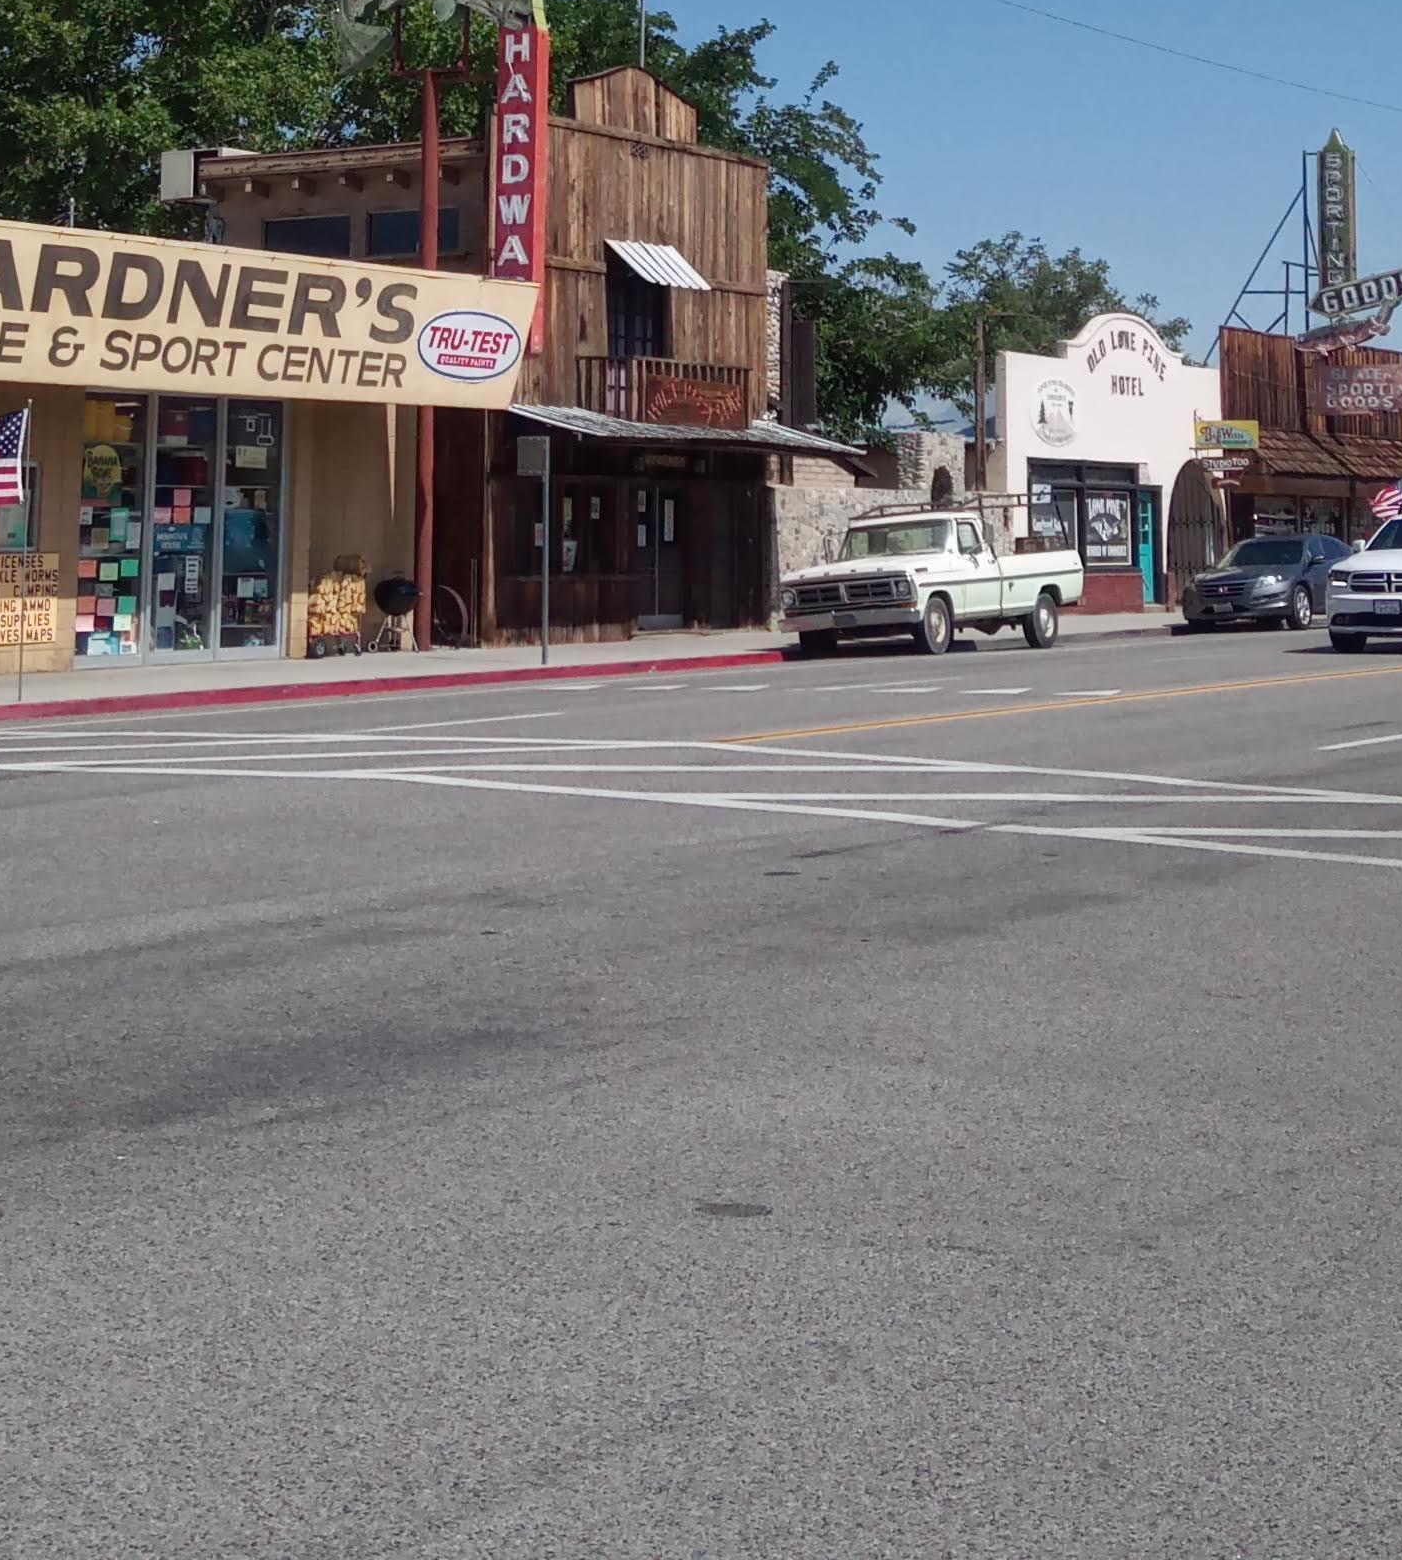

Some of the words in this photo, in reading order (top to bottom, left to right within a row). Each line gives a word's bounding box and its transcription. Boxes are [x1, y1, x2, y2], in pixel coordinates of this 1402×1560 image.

[497, 33, 532, 280] HARDWA
[1325, 152, 1344, 284] SPORTING
[429, 326, 514, 355] TRU-TEST
[48, 325, 85, 368] &
[99, 328, 247, 377] SPORT
[256, 343, 408, 388] CENTER
[440, 355, 469, 366] QUALITY
[470, 358, 494, 368] PAINTS
[1087, 339, 1107, 374] OLD
[1111, 331, 1136, 351] LONE
[1142, 338, 1166, 381] PINE
[1111, 375, 1144, 396] HOTEL
[1327, 396, 1394, 408] GOODS
[1203, 458, 1232, 468] STUDIO
[25, 570, 58, 582] WORMS
[14, 584, 57, 597] CMPING
[22, 599, 50, 611] AMMO
[1, 614, 50, 627] SUPPLIES
[27, 628, 53, 640] MAPS
